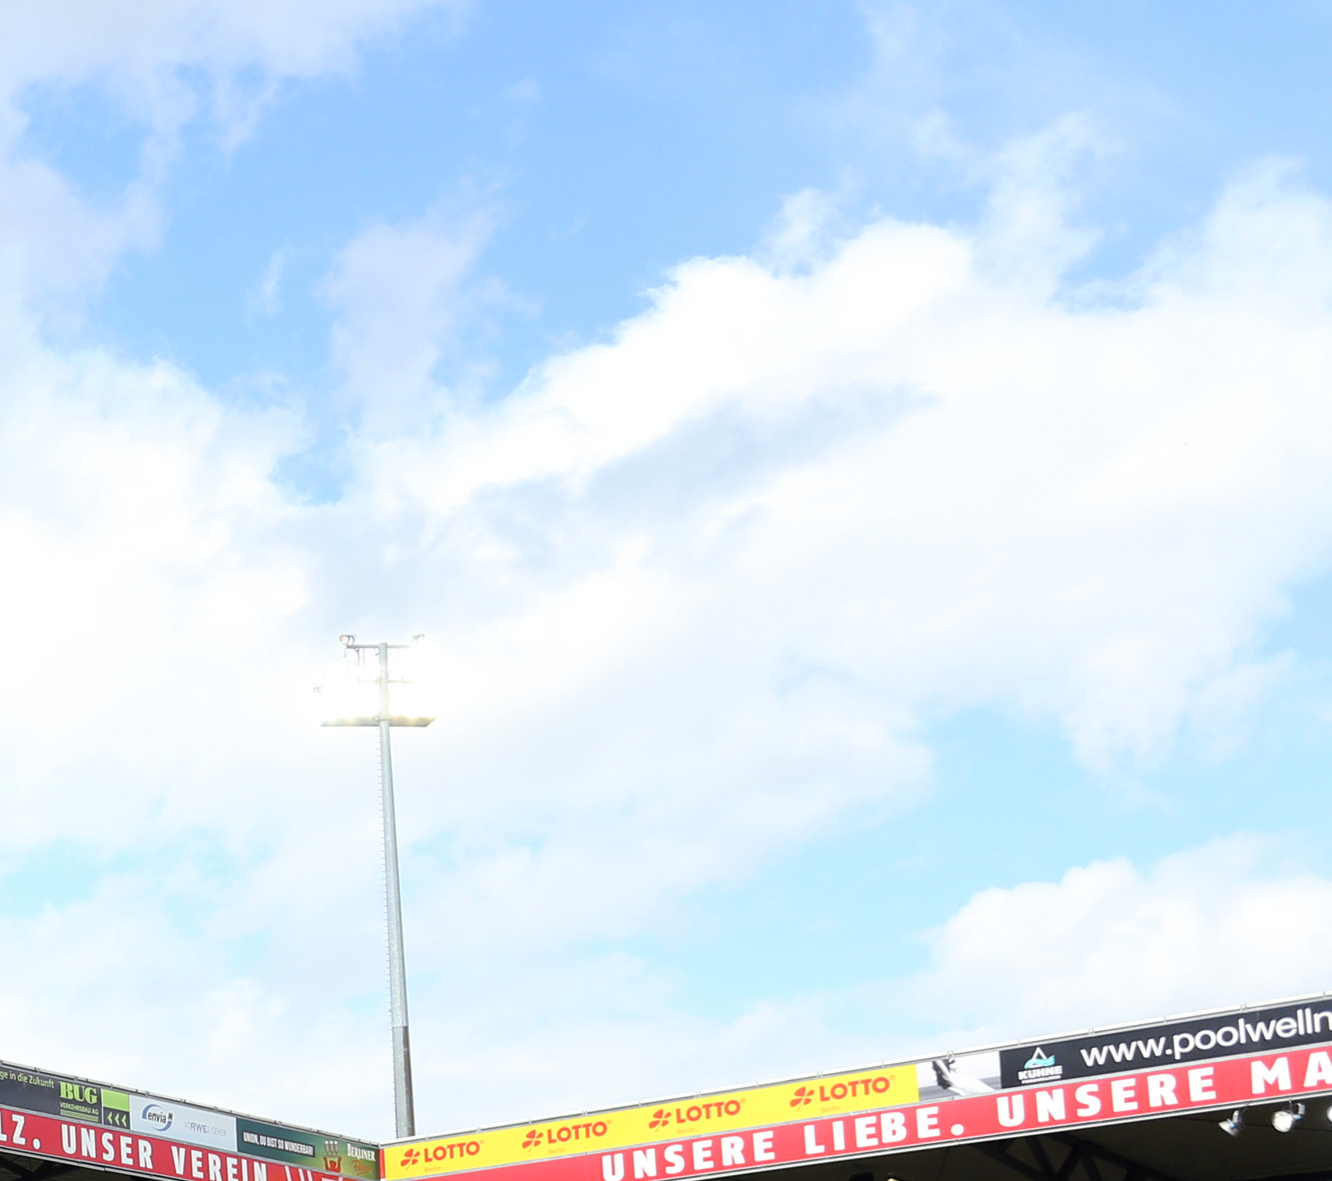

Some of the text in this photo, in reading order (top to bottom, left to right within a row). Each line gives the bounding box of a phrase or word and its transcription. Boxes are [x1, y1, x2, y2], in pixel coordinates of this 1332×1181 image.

[17, 1070, 28, 1082] die
[28, 1074, 55, 1089] Zukunft
[819, 1076, 890, 1102] LOTTO
[59, 1081, 98, 1105] BUG
[676, 1099, 741, 1124] LOTTO
[804, 1105, 965, 1155] LIEBE.
[997, 1067, 1217, 1127] UNSERE
[547, 1121, 608, 1144] LOTTO
[61, 1123, 154, 1170] UNSER
[347, 1143, 376, 1162] BERLINER
[424, 1140, 480, 1162] LOTTO
